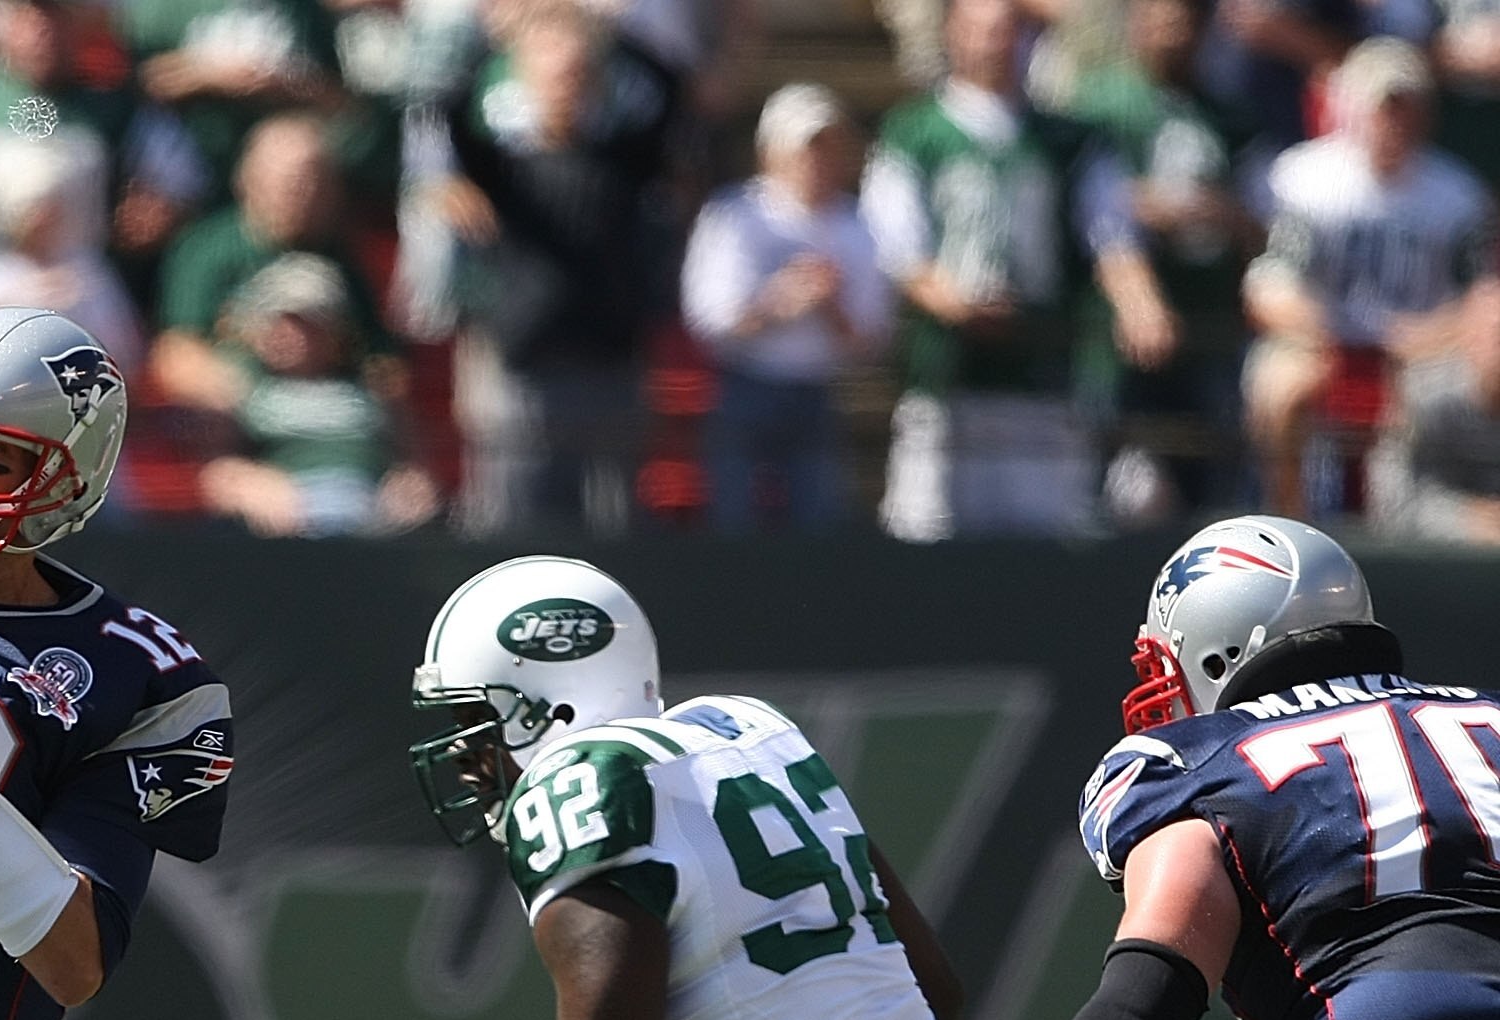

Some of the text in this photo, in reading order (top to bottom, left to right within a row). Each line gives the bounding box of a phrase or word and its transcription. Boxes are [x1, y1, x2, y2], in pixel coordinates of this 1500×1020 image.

[101, 606, 205, 673] 12
[510, 617, 599, 642] JETS
[512, 762, 610, 873] 92
[712, 752, 898, 976] 92
